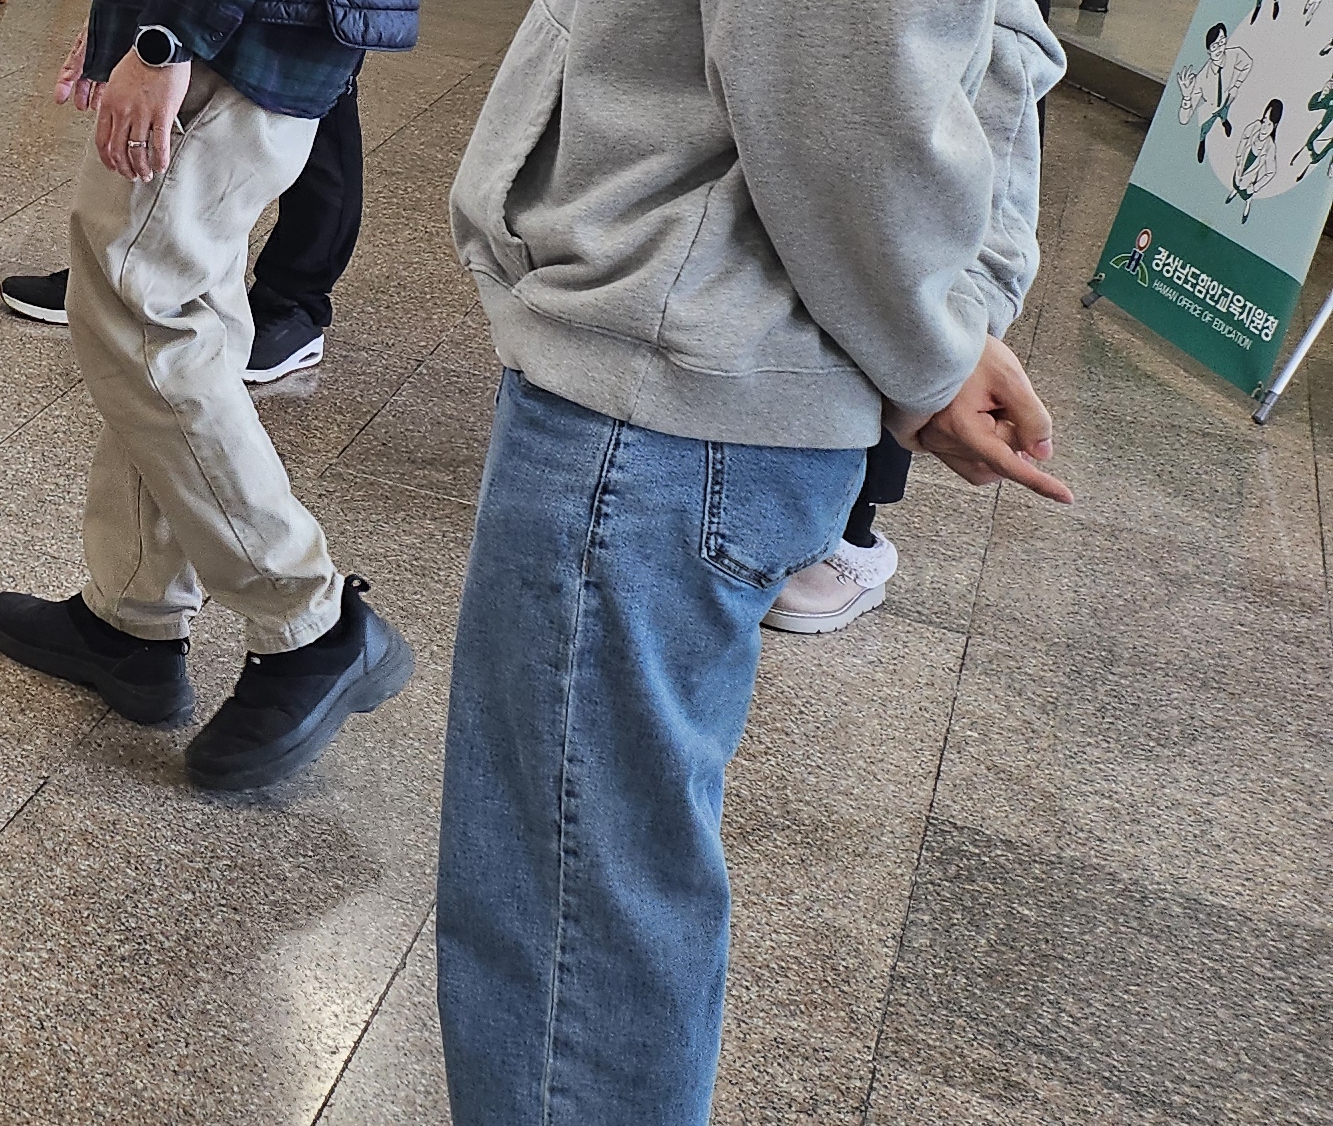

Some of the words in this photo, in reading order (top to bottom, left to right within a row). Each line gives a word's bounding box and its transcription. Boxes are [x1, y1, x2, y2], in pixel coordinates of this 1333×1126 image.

[1151, 246, 1279, 343] 경상남도함안교육지원청
[1152, 279, 1180, 303] HAMAN
[1177, 295, 1201, 318] OFFICE
[1201, 310, 1214, 323] OF
[1212, 318, 1253, 351] EDUCATION
